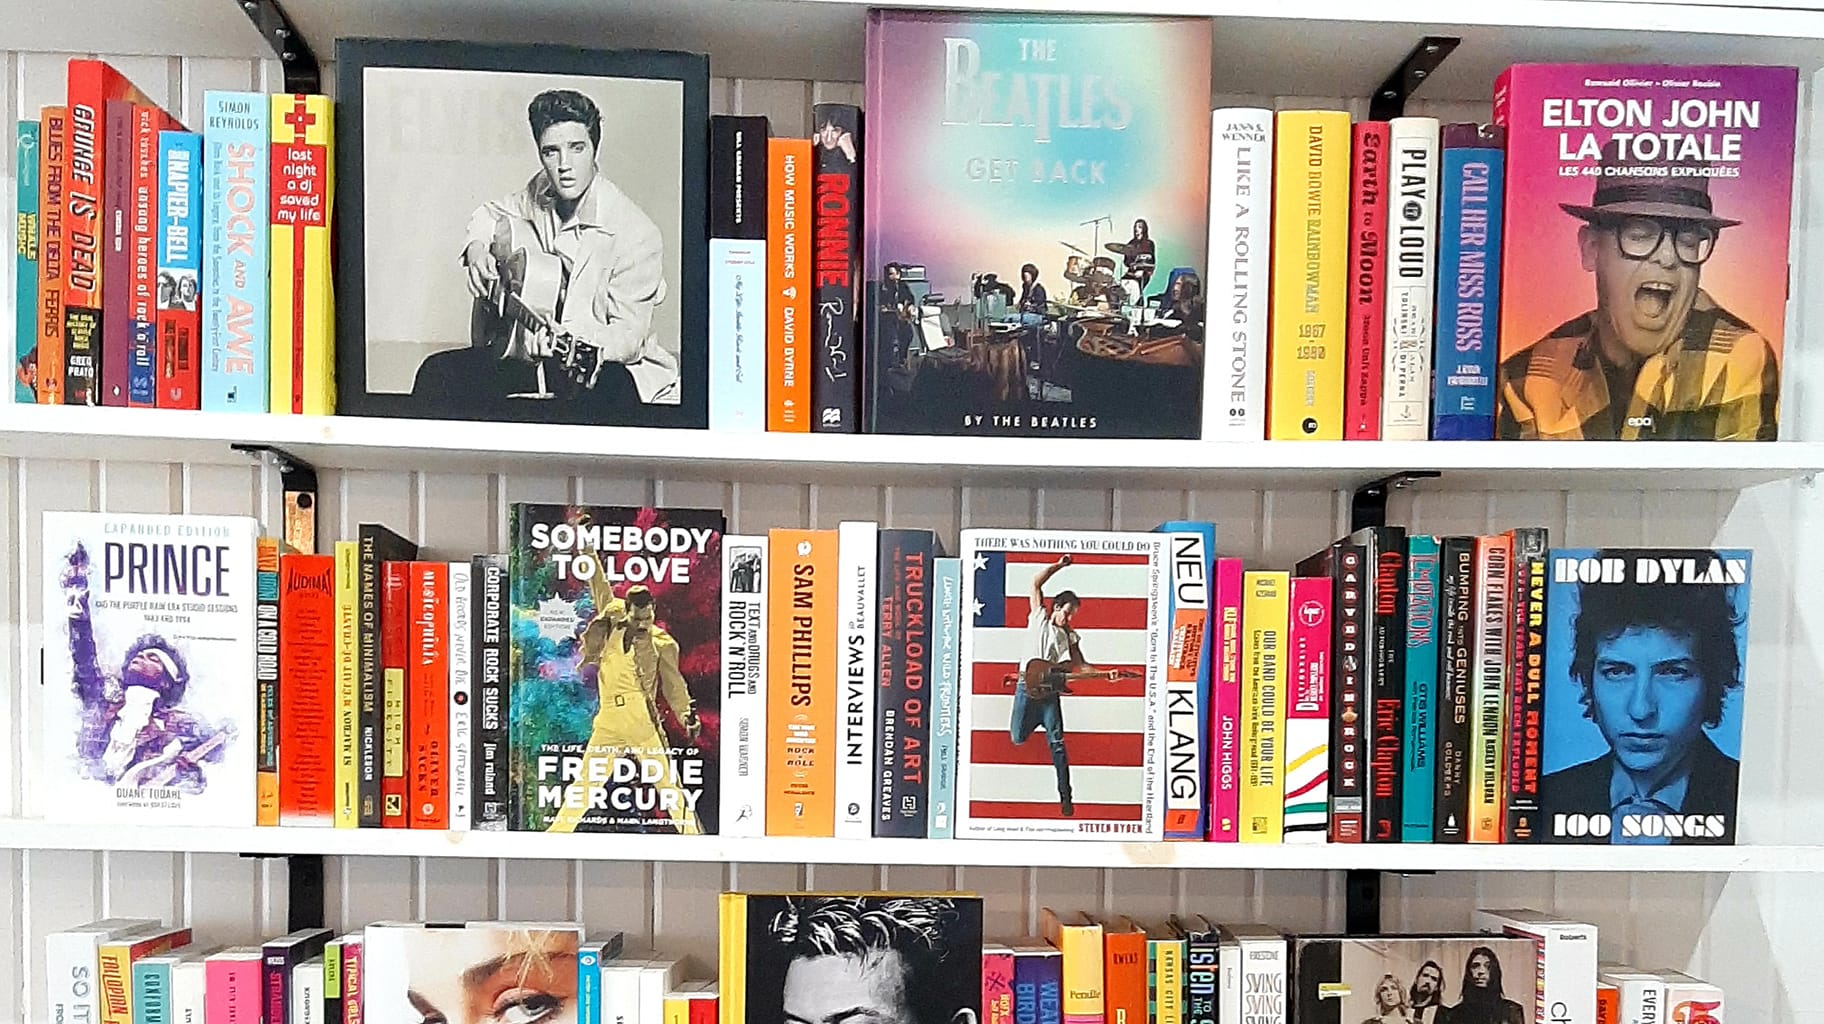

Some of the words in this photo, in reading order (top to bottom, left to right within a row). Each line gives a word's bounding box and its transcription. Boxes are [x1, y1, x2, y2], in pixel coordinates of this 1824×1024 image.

[1543, 100, 1651, 127] ELTON
[1663, 102, 1760, 128] JOHN
[288, 149, 312, 161] last
[1559, 134, 1601, 160] LA
[1611, 134, 1741, 161] TOTALE
[283, 163, 316, 176] night
[785, 155, 795, 185] HOW
[1237, 147, 1251, 196] LIKE
[226, 143, 254, 256] SHOCK
[278, 211, 296, 222] my
[300, 208, 320, 220] life
[280, 194, 318, 206] saved
[784, 190, 794, 237] MUSIC
[1236, 204, 1249, 218] A
[817, 174, 849, 288] RONNIE
[234, 260, 245, 287] AND
[784, 238, 794, 279] WORKS
[1234, 226, 1249, 326] ROLLING
[226, 296, 254, 375] AWE
[785, 308, 794, 344] DAVID
[784, 348, 793, 387] BYRNE
[1231, 332, 1246, 403] STONE
[965, 415, 983, 426] BY
[994, 415, 1021, 427] THE
[1031, 416, 1097, 428] BEATLES
[105, 523, 170, 536] EXPANDED
[178, 525, 230, 537] EDITION
[531, 524, 713, 553] SOMEBODY
[105, 542, 230, 596] PRINCE
[552, 555, 595, 580] TO
[606, 557, 690, 583] LOVE
[794, 565, 814, 609] SAM
[1174, 538, 1204, 604] NEU
[1555, 559, 1625, 583] BOB
[1636, 559, 1746, 583] DYLAN
[485, 567, 499, 643] CORPORATE
[1529, 562, 1544, 627] NEVER
[903, 551, 923, 691] TRUCKLOAD
[1529, 632, 1543, 646] A
[485, 649, 499, 683] ROCK
[791, 616, 813, 706] PHILLIPS
[1528, 654, 1541, 704] DULL
[484, 688, 498, 730] SUCKS
[848, 634, 864, 765] INTERVIEWS
[904, 698, 922, 728] OF
[884, 710, 895, 766] BRENDAN
[1168, 690, 1195, 799] KLANG
[1524, 711, 1539, 794] MOMENT
[538, 757, 703, 783] FREDDIE
[903, 737, 921, 784] ART
[538, 787, 703, 810] MERCURY
[882, 771, 892, 821] GREAVES
[1079, 823, 1112, 832] STEVEN
[1115, 824, 1143, 833] HYDEN
[1553, 815, 1611, 837] 100
[1622, 815, 1725, 837] SONGS
